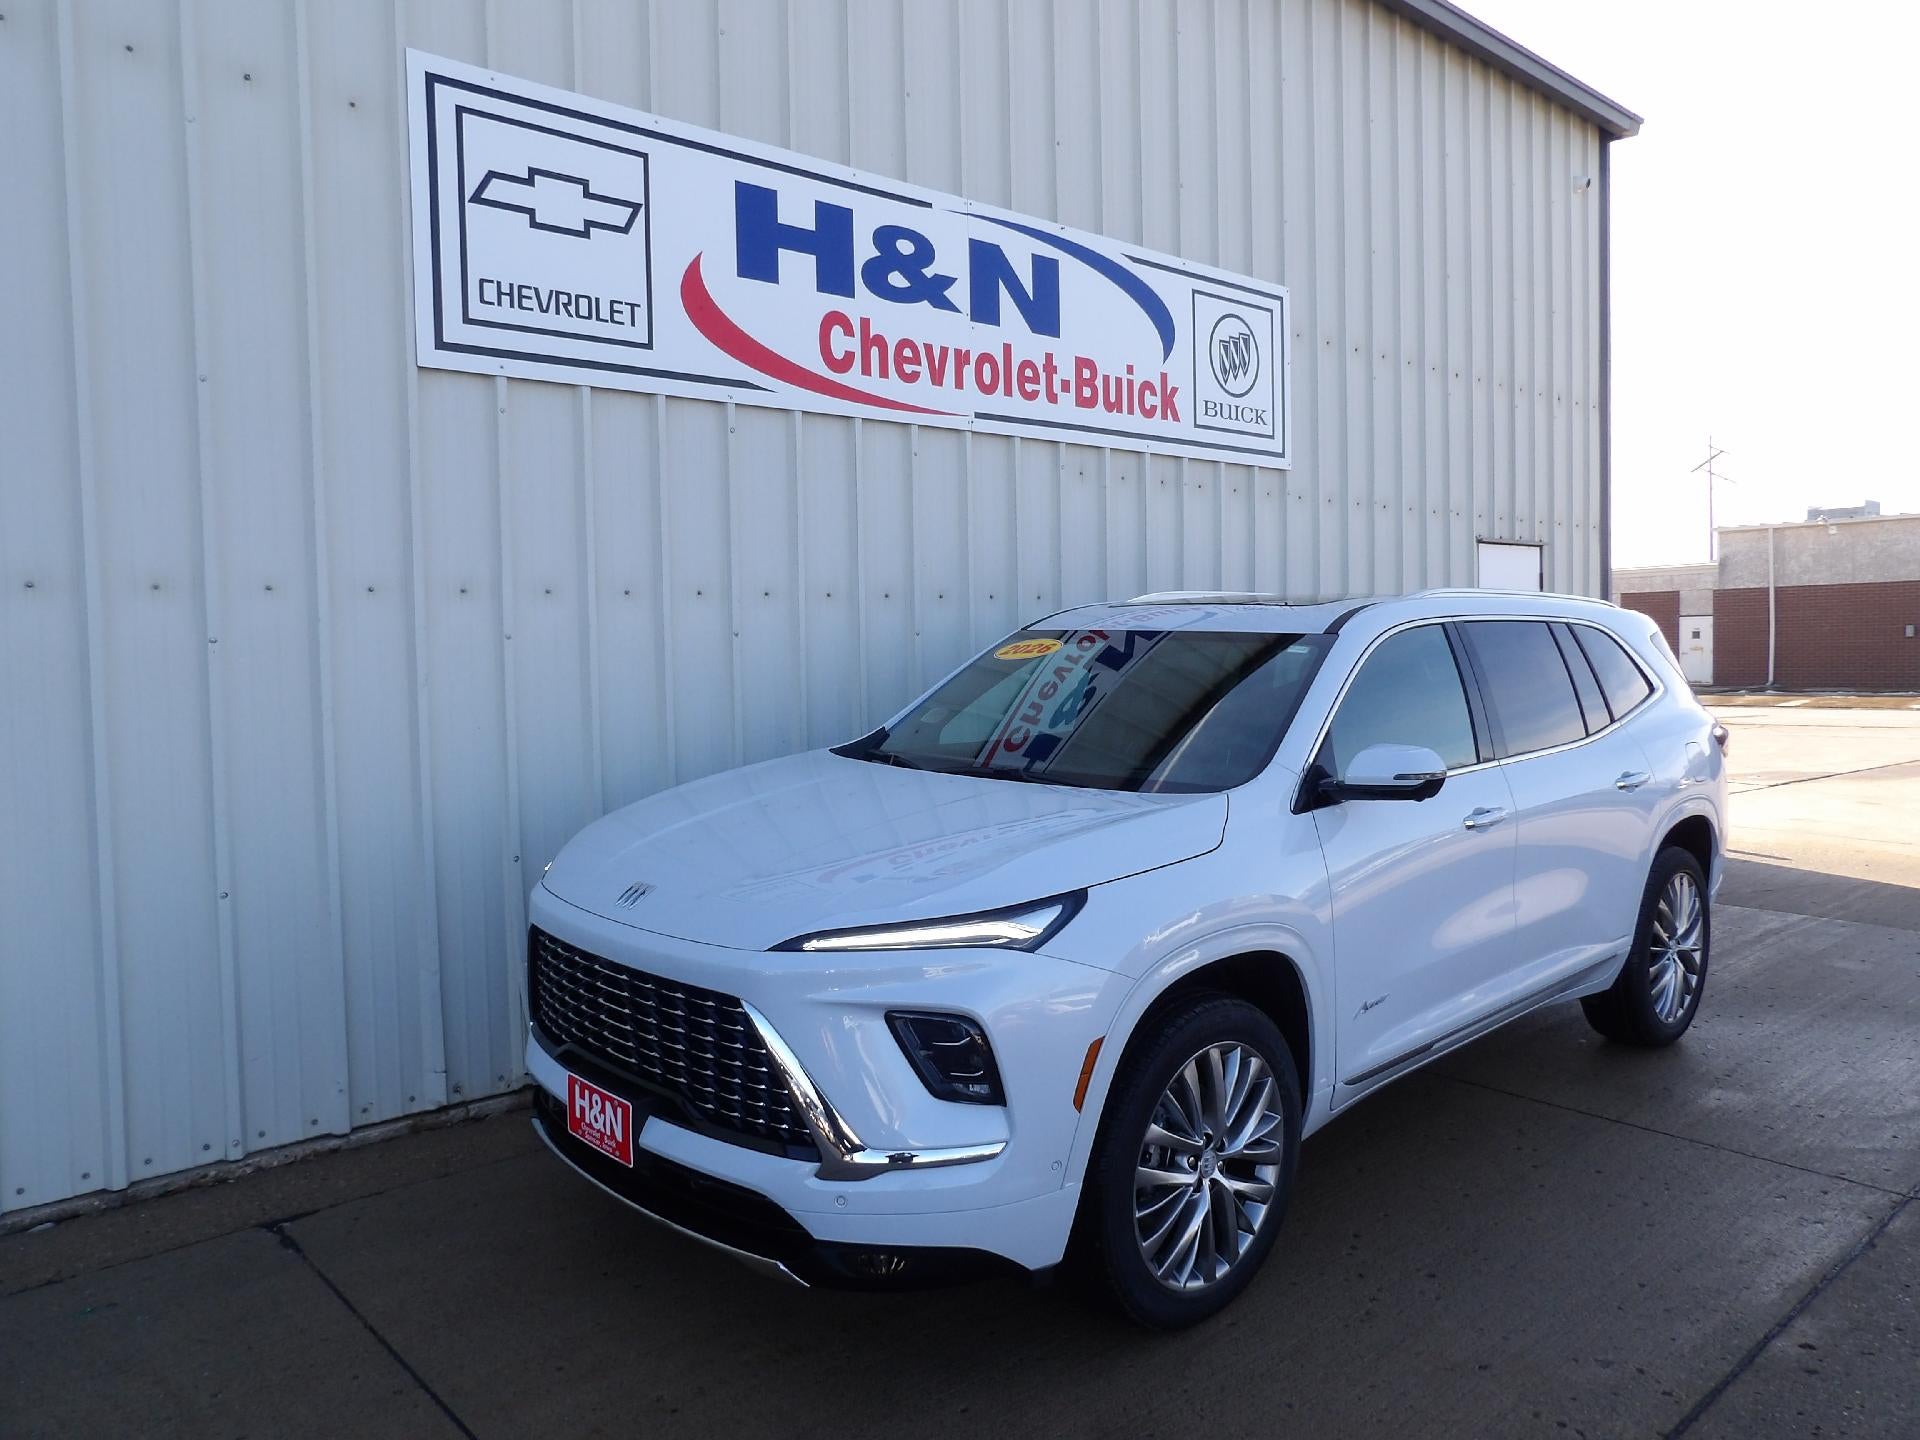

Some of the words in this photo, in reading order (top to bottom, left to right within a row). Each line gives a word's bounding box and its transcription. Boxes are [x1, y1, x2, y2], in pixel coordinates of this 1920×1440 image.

[735, 180, 1061, 338] H&N
[478, 277, 641, 328] CHEVROLET
[818, 310, 1181, 423] Chevrolet-Buick
[1203, 399, 1268, 426] BUICK
[574, 1083, 623, 1142] H&N
